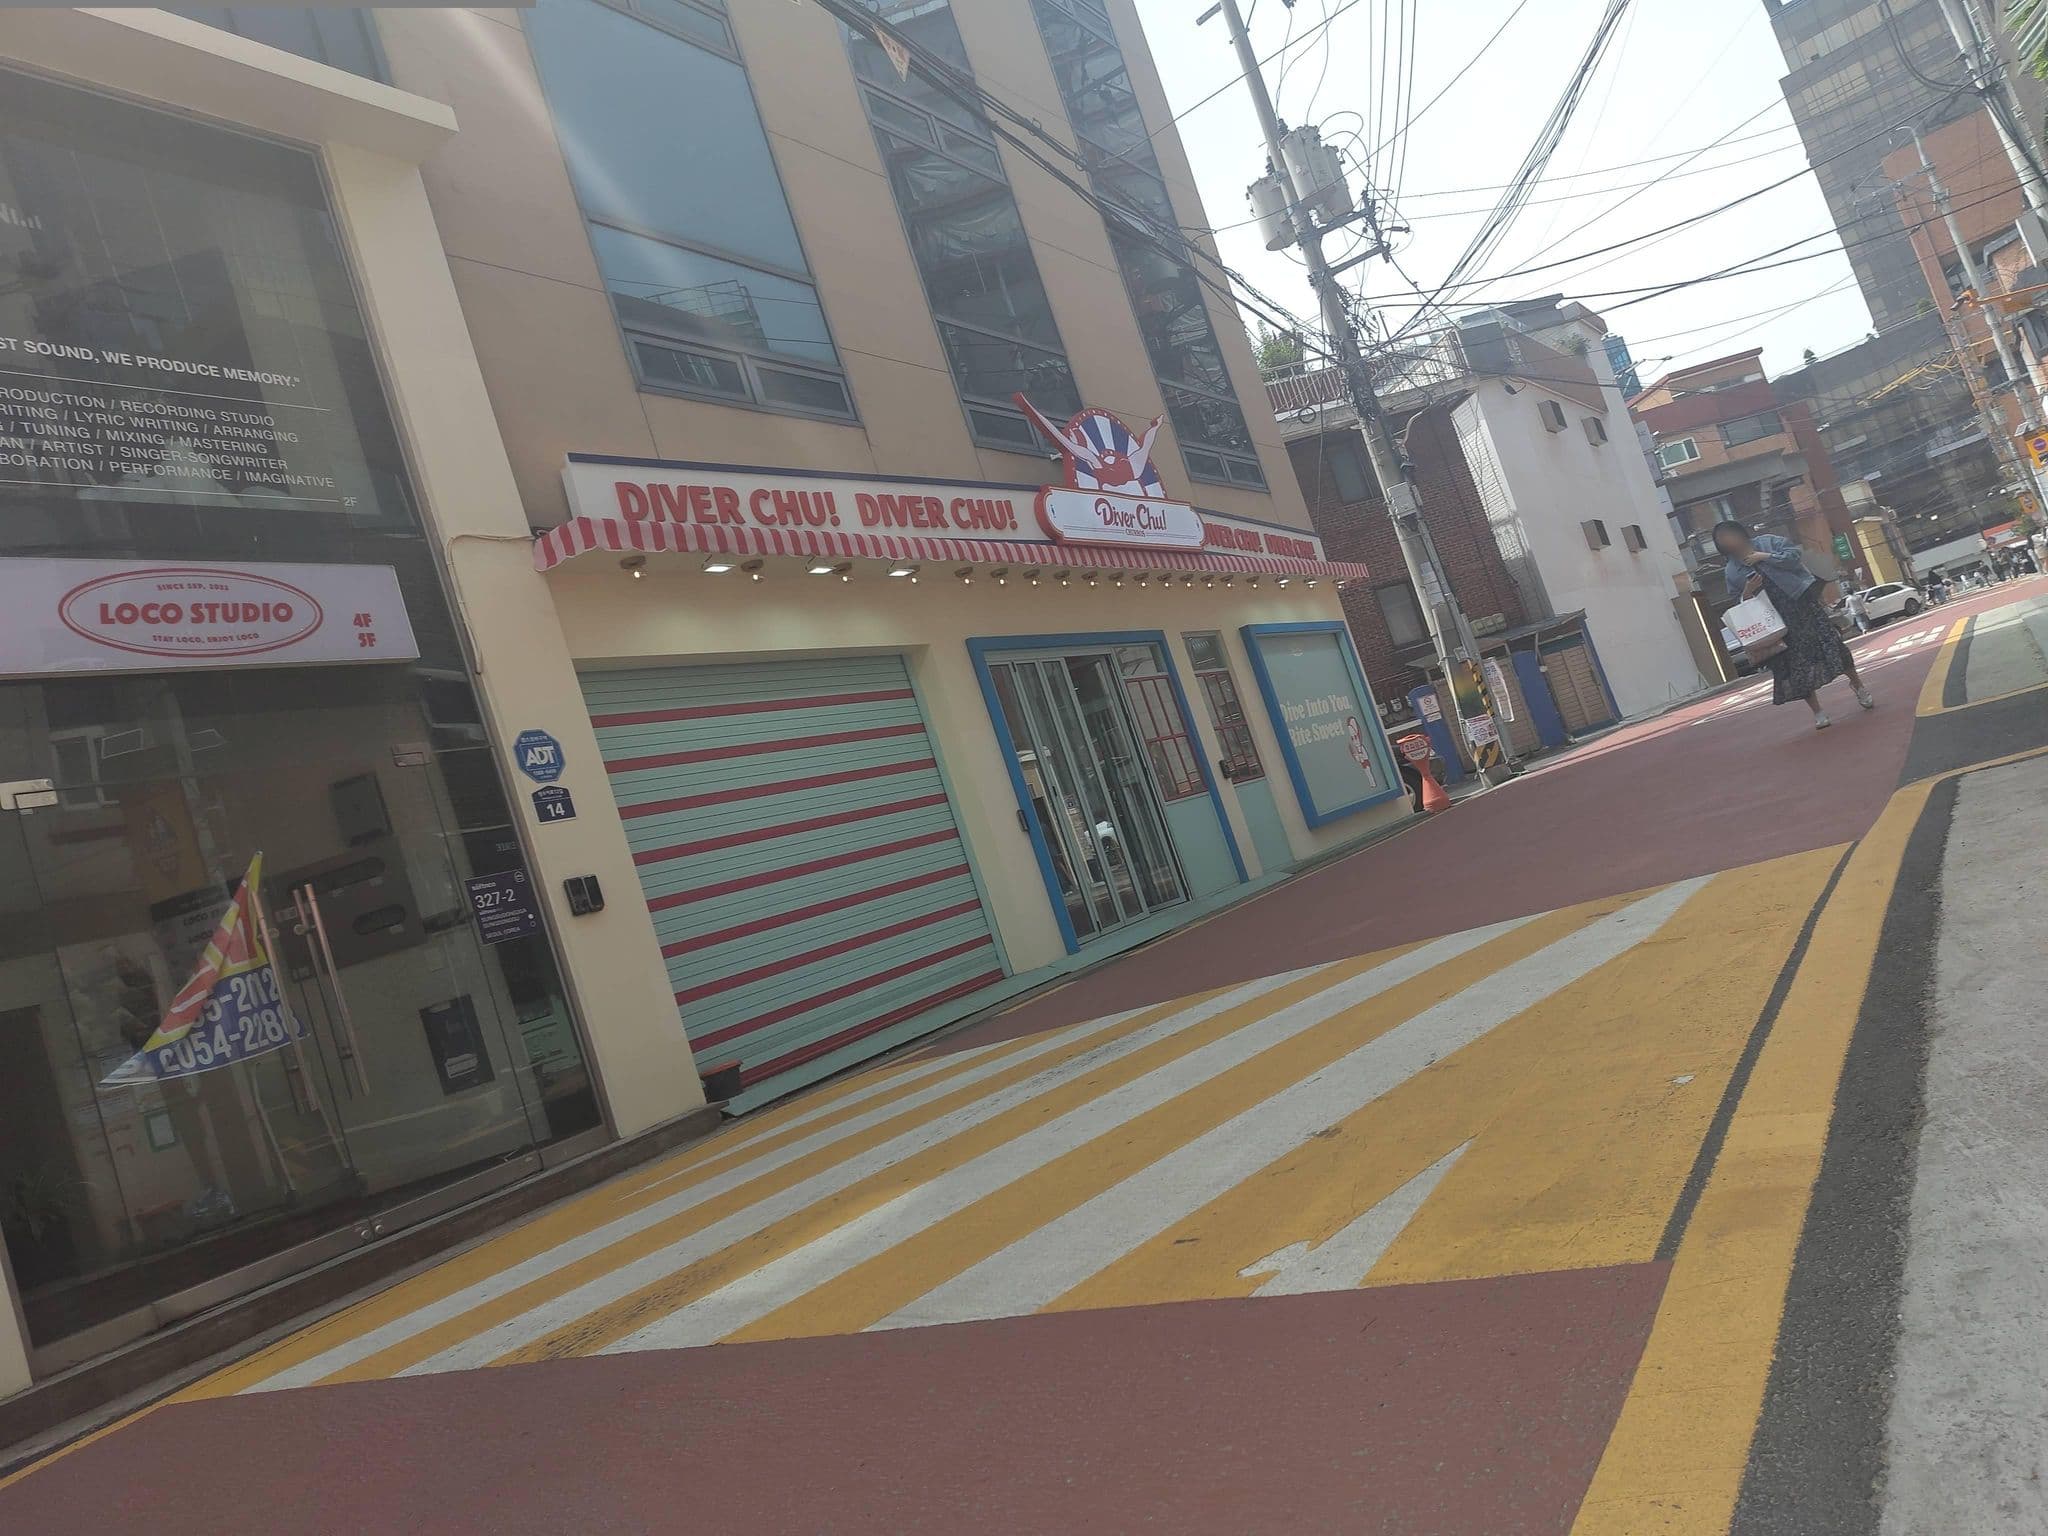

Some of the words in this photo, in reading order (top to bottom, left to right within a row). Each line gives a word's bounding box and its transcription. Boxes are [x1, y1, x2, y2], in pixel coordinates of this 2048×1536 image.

[24, 340, 100, 364] SOUND,
[102, 350, 133, 366] WE
[136, 355, 221, 378] PRODUCE
[0, 387, 105, 410] RODUCTION
[120, 400, 216, 421] RECORDING
[220, 411, 275, 427] STUDIO
[19, 422, 90, 440] TUNING
[106, 429, 165, 445] MIXING
[179, 437, 268, 454] MASTERING
[74, 411, 125, 427] LYRIC
[129, 415, 199, 433] WRITING
[214, 425, 299, 443] ARRANGING
[42, 440, 104, 456] ARTIST
[120, 446, 288, 470] SINGER-SONGWRITER
[0, 453, 94, 471] BORATION
[109, 461, 232, 481] PERFORMANCE
[245, 471, 336, 488] IMAGINATIVE
[343, 496, 358, 507] 2F
[614, 481, 745, 525] DIVER
[749, 488, 841, 528] CHU!
[854, 493, 950, 530] DIVER
[950, 497, 1018, 530] CHU!
[1094, 498, 1135, 527] Diver
[1136, 503, 1167, 530] Chu!
[1234, 528, 1264, 553] CHU!
[100, 602, 184, 625] LOCO
[190, 602, 293, 625] STUDIO
[353, 613, 373, 628] 4F
[1305, 699, 1330, 718] Into
[526, 745, 554, 767] ADT
[546, 802, 566, 818] 14
[475, 888, 517, 909] 327-2
